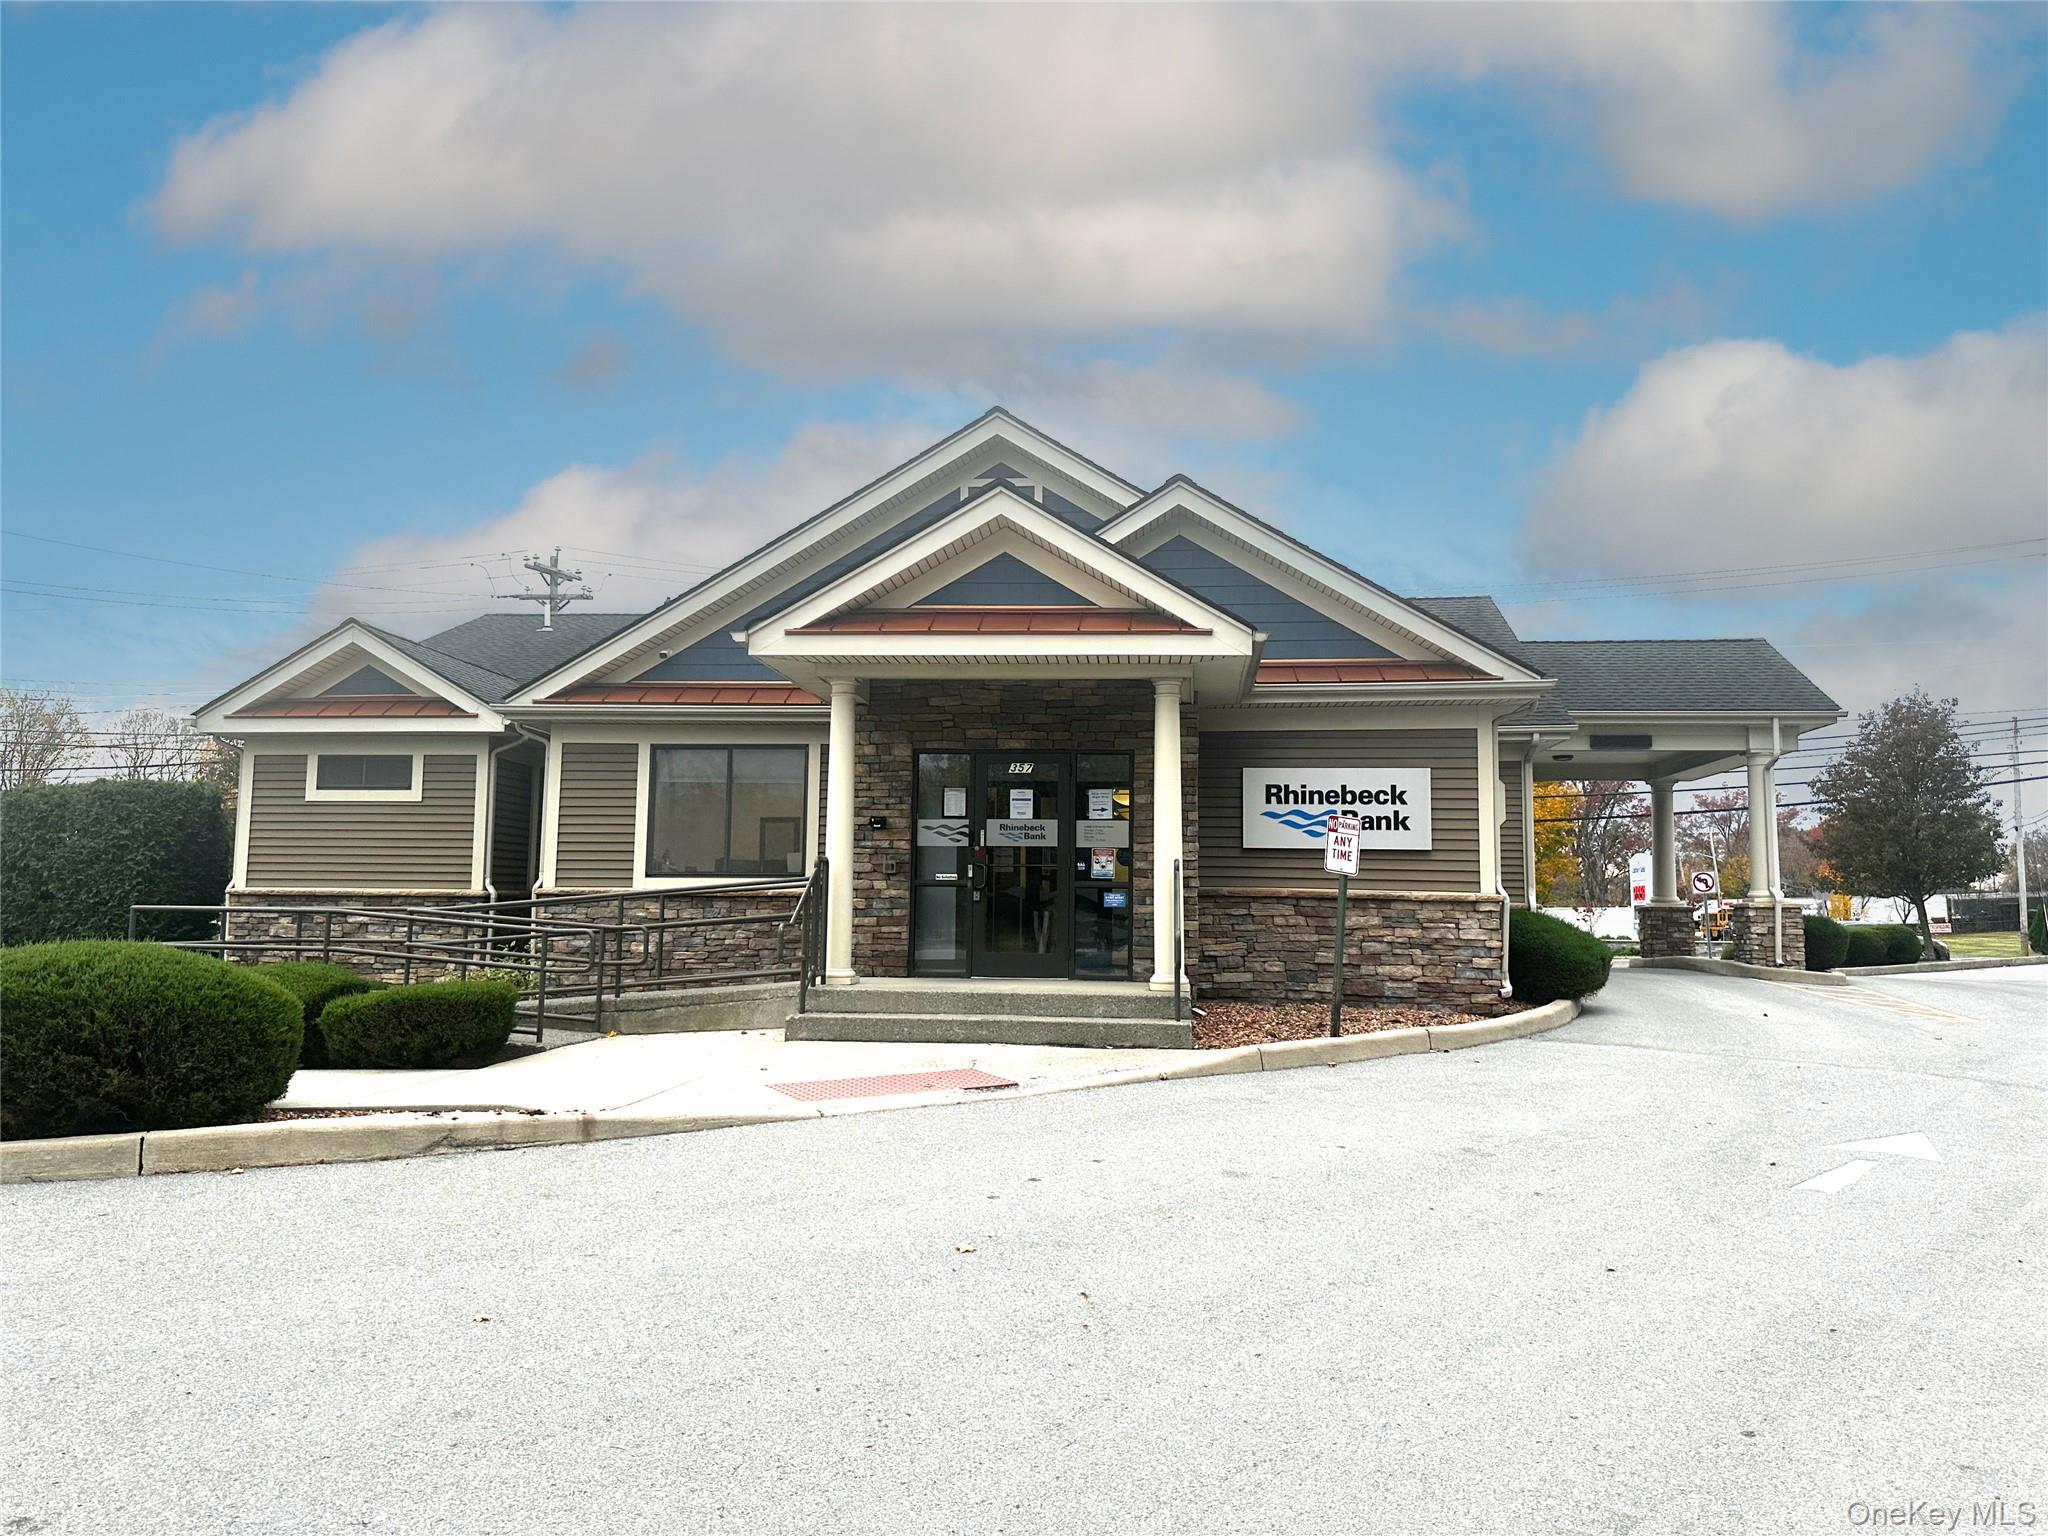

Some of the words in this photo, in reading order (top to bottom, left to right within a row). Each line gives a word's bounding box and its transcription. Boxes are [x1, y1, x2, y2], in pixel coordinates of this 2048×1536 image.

[1010, 763, 1033, 773] 357
[1265, 784, 1408, 805] Rhinebeck
[1000, 823, 1046, 831] Rhinebeck
[1328, 818, 1338, 831] NO
[1338, 821, 1359, 832] PARKING
[1023, 832, 1047, 840] Bank
[1333, 835, 1353, 848] ANY
[1332, 848, 1353, 862] TIME
